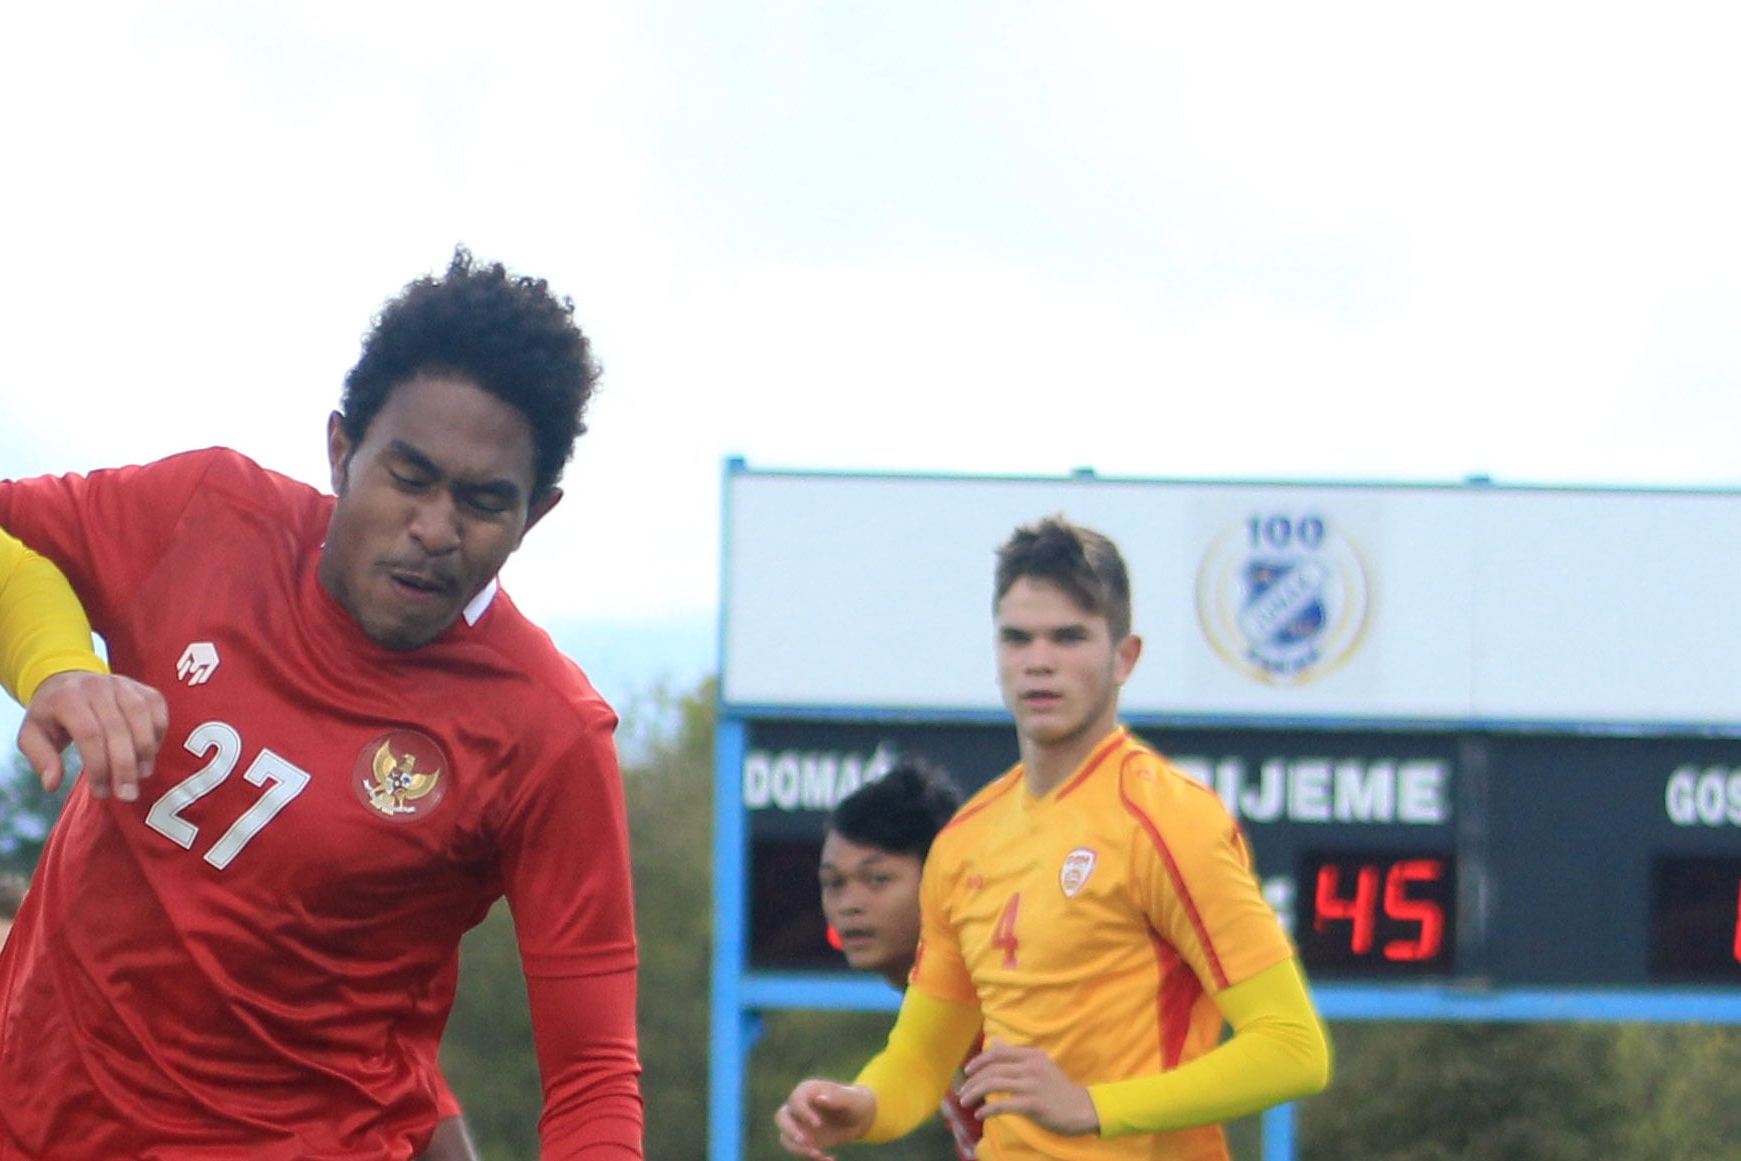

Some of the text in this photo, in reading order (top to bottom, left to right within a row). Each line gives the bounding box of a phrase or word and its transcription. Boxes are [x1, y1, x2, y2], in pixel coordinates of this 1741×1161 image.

[1247, 514, 1324, 547] 100
[146, 721, 311, 870] 27
[993, 892, 1020, 969] 4
[1315, 860, 1444, 960] 45
